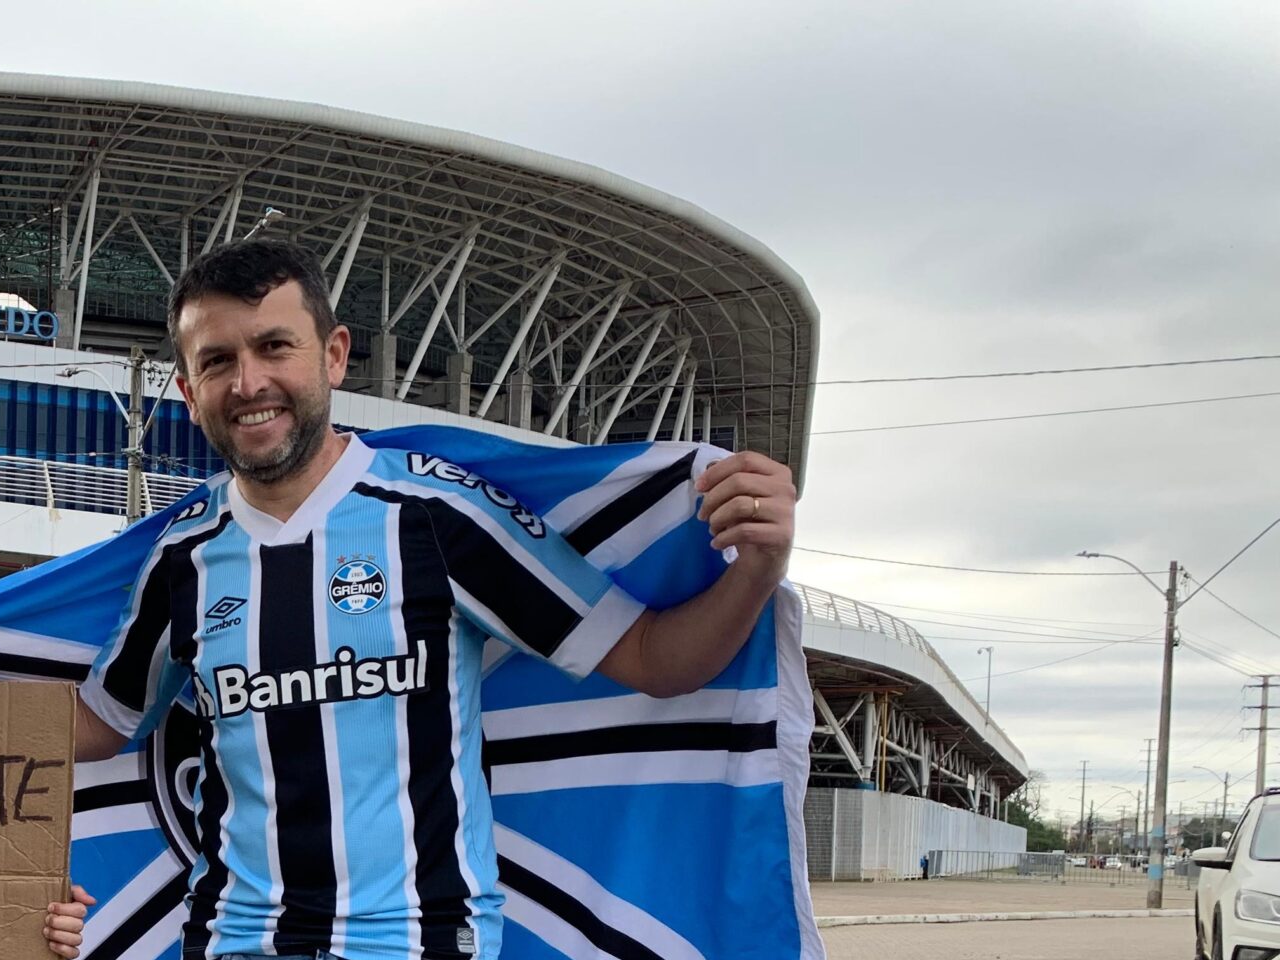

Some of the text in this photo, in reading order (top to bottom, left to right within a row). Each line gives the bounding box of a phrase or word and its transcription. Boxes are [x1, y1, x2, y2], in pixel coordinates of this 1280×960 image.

[332, 581, 383, 597] GRÊMIO
[205, 616, 242, 635] umbro
[216, 639, 428, 715] Banrisul
